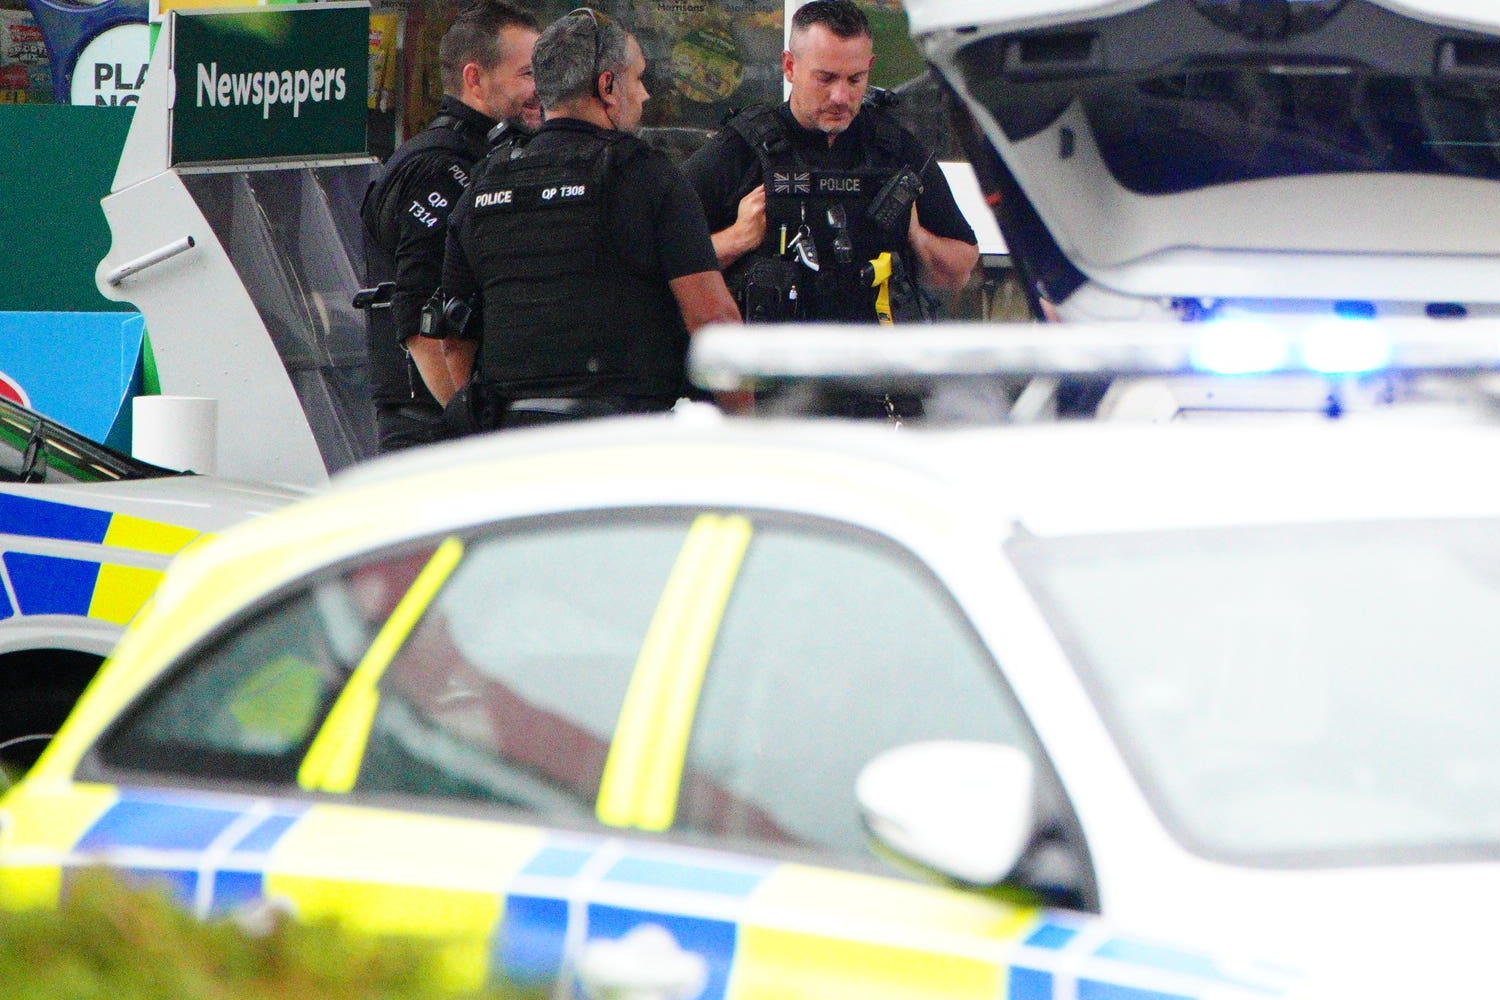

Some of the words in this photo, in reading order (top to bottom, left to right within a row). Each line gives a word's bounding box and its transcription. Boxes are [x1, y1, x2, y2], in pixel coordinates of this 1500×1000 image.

[196, 61, 347, 120] Newspapers
[541, 187, 557, 201] QP
[559, 184, 586, 198] T308
[819, 177, 861, 192] POLICE
[428, 190, 448, 210] QP
[474, 189, 513, 209] POLICE
[408, 200, 439, 229] T314
